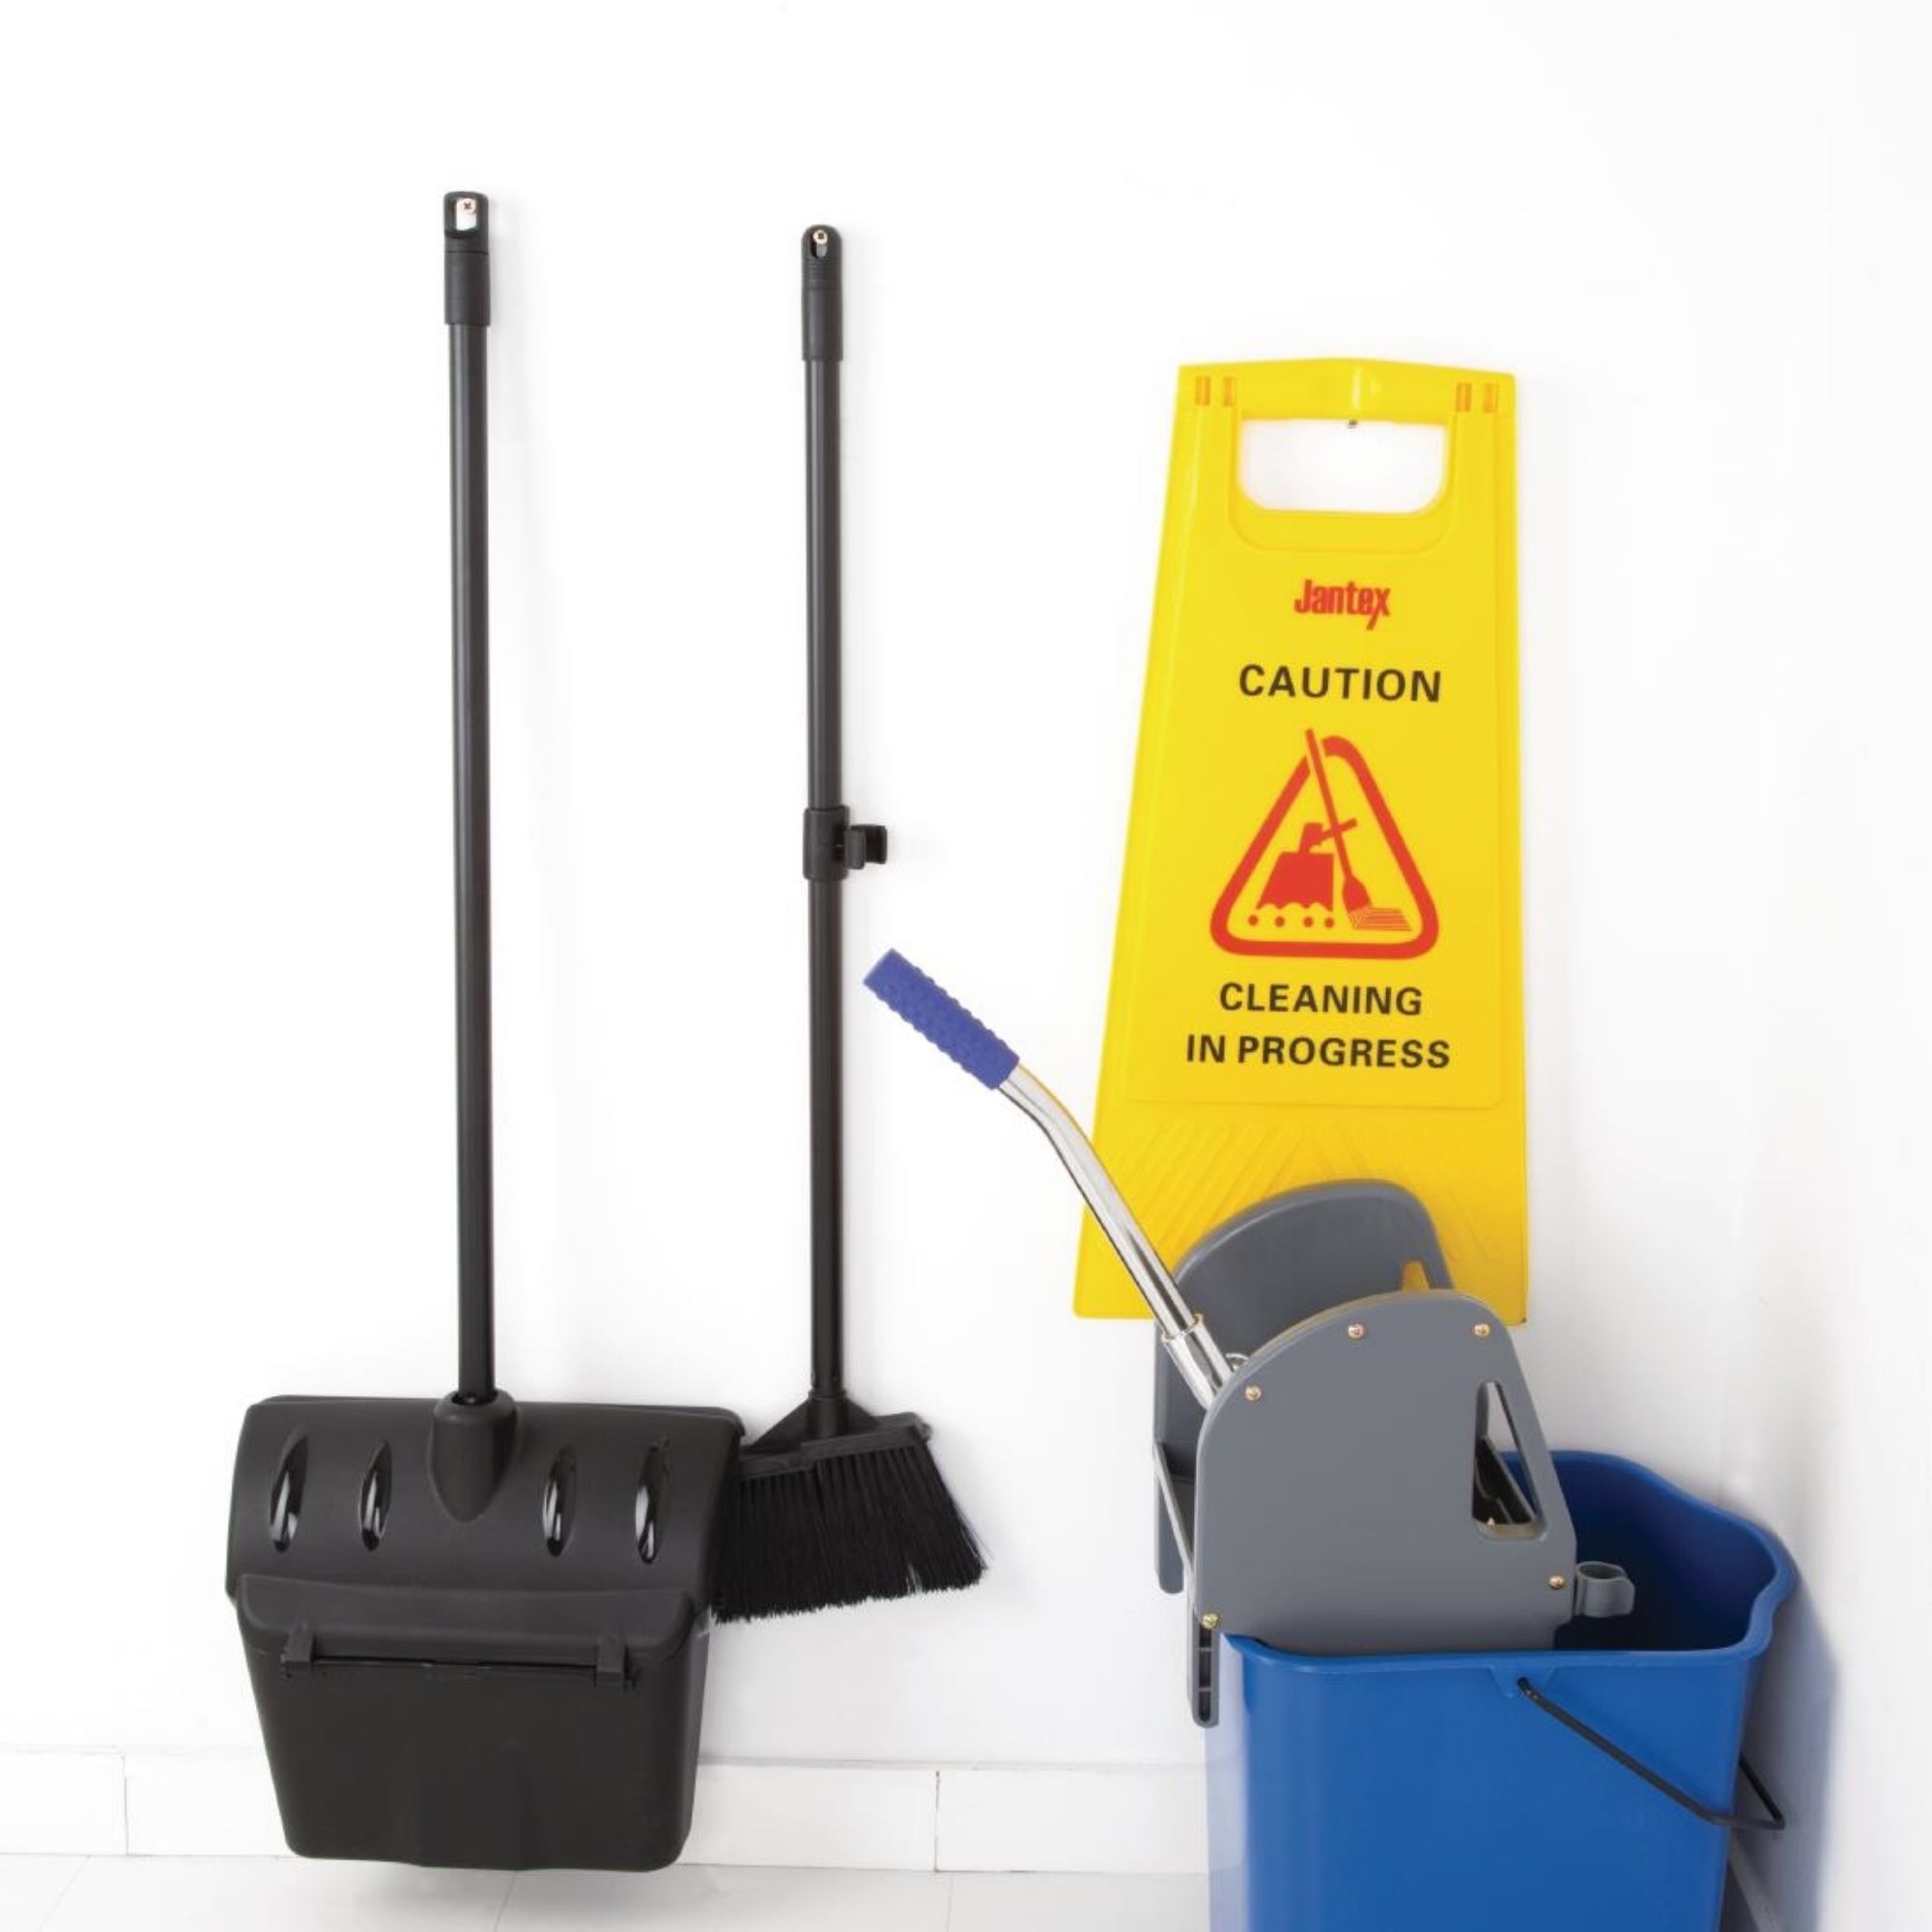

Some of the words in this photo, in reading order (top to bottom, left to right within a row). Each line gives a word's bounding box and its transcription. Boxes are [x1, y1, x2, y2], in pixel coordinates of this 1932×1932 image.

[1293, 579, 1391, 631] Jantex
[1238, 663, 1441, 703] CAUTION
[1219, 980, 1423, 1017] CLEANING
[1186, 1034, 1227, 1065] IN
[1236, 1035, 1451, 1069] PROGRESS
